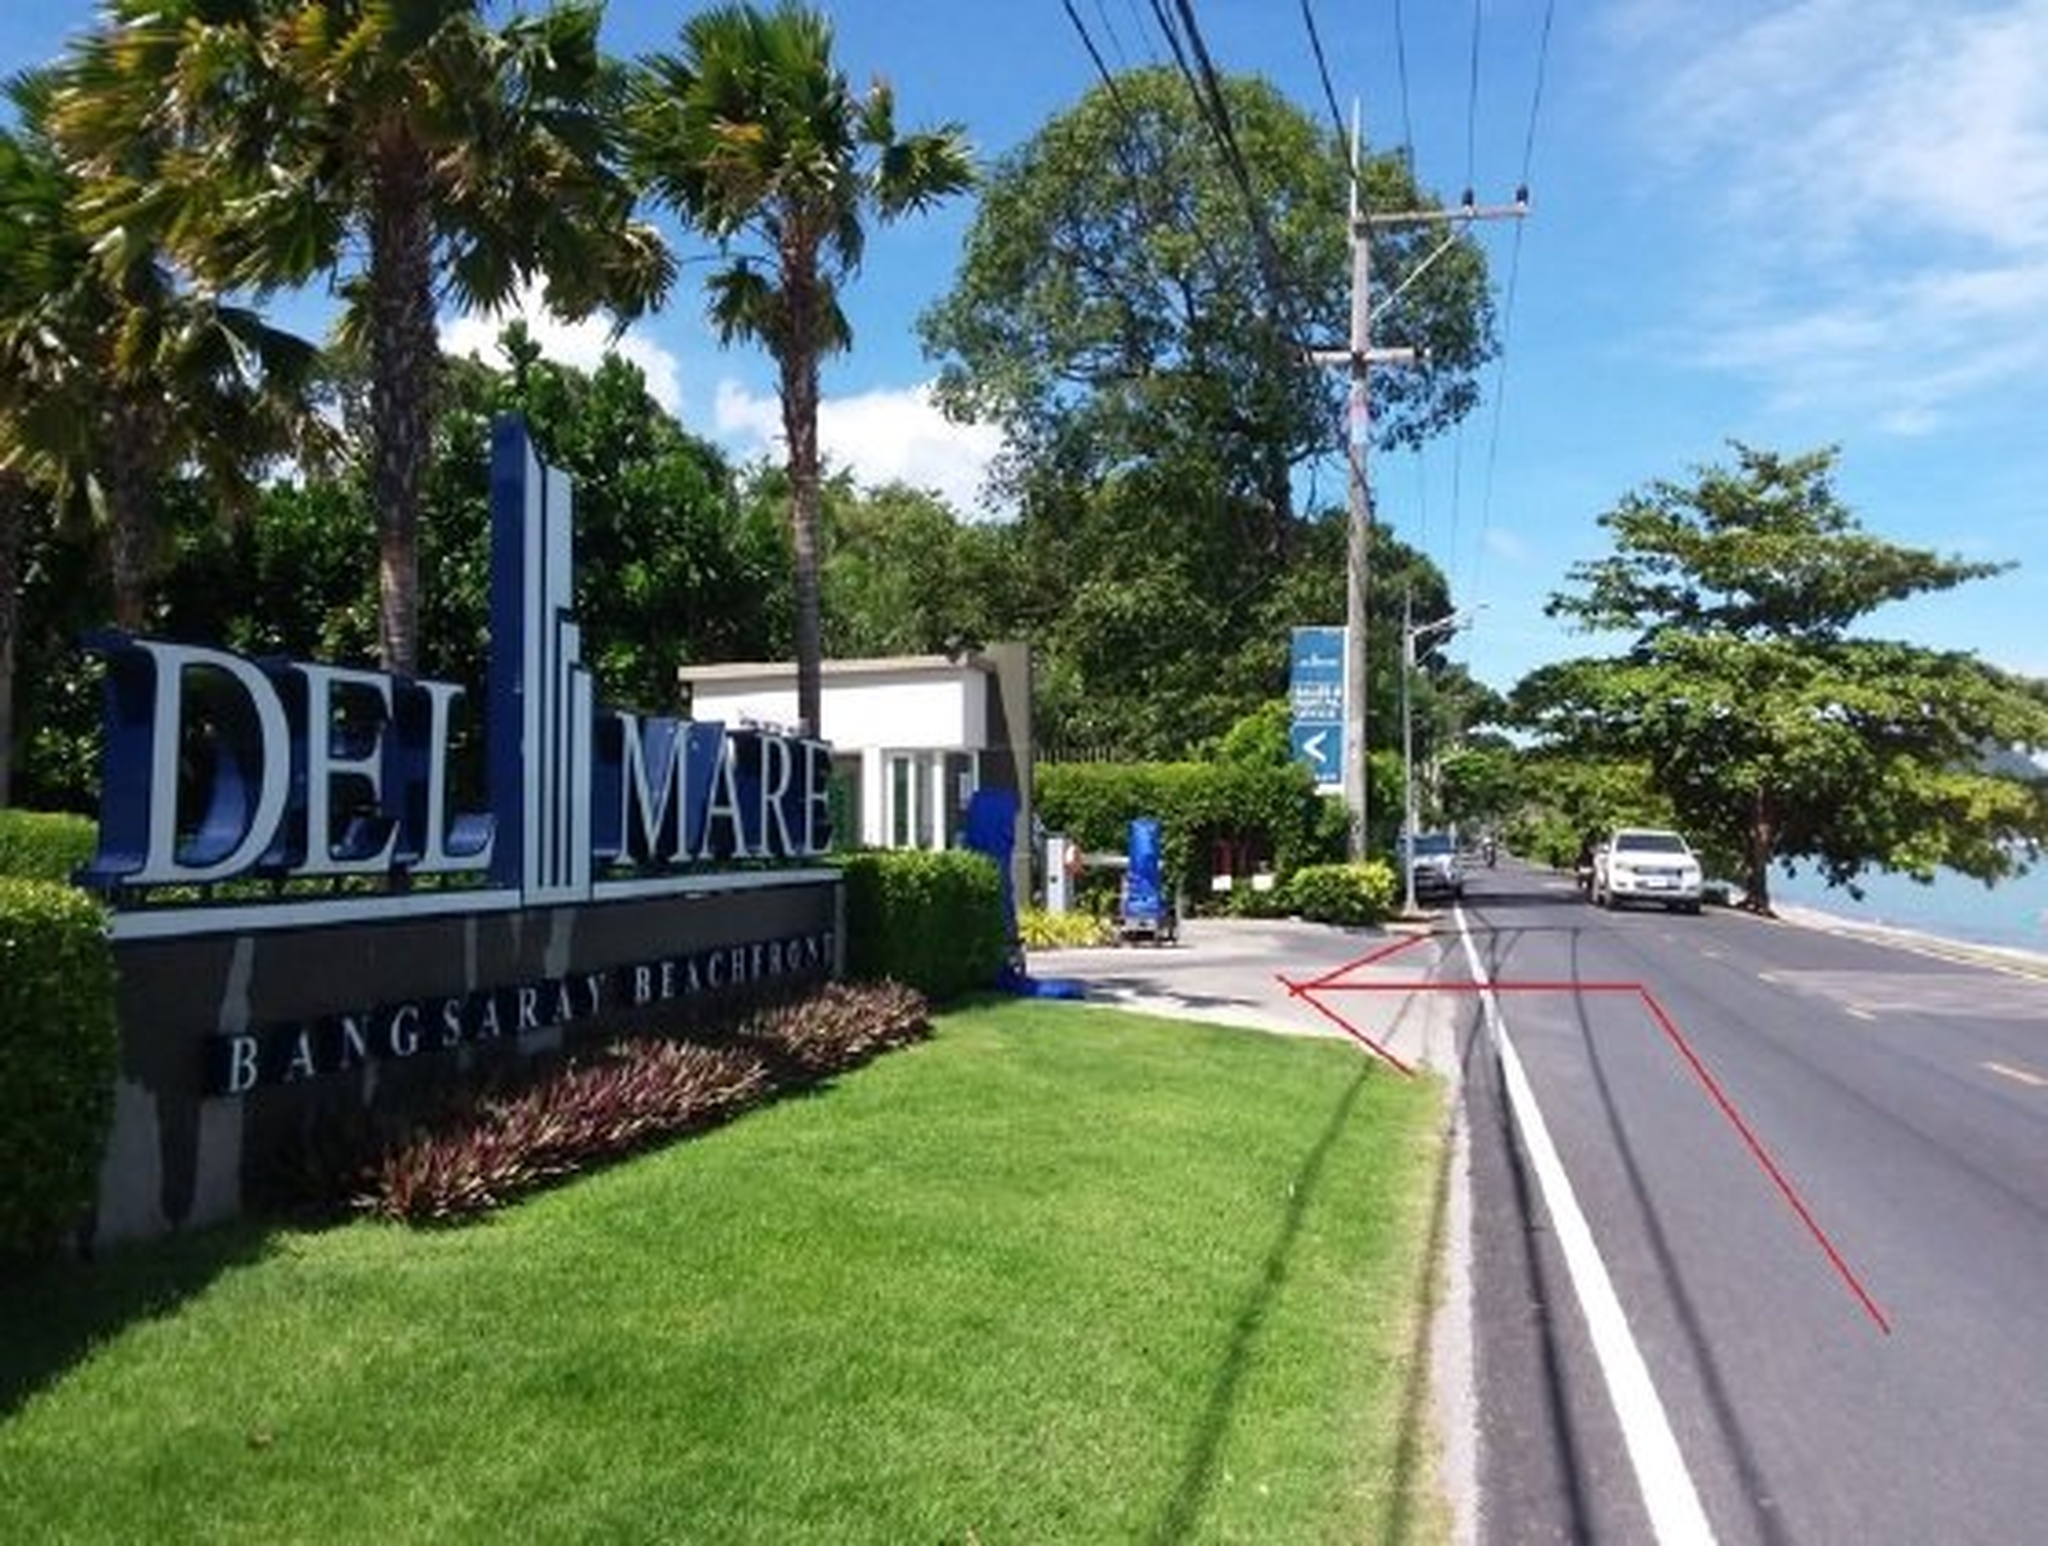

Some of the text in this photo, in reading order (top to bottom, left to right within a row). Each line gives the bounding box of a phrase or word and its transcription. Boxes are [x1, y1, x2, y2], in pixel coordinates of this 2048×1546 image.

[123, 639, 834, 883] DEL MARE
[229, 931, 834, 1093] BANGSARAY BEACHFRONT
